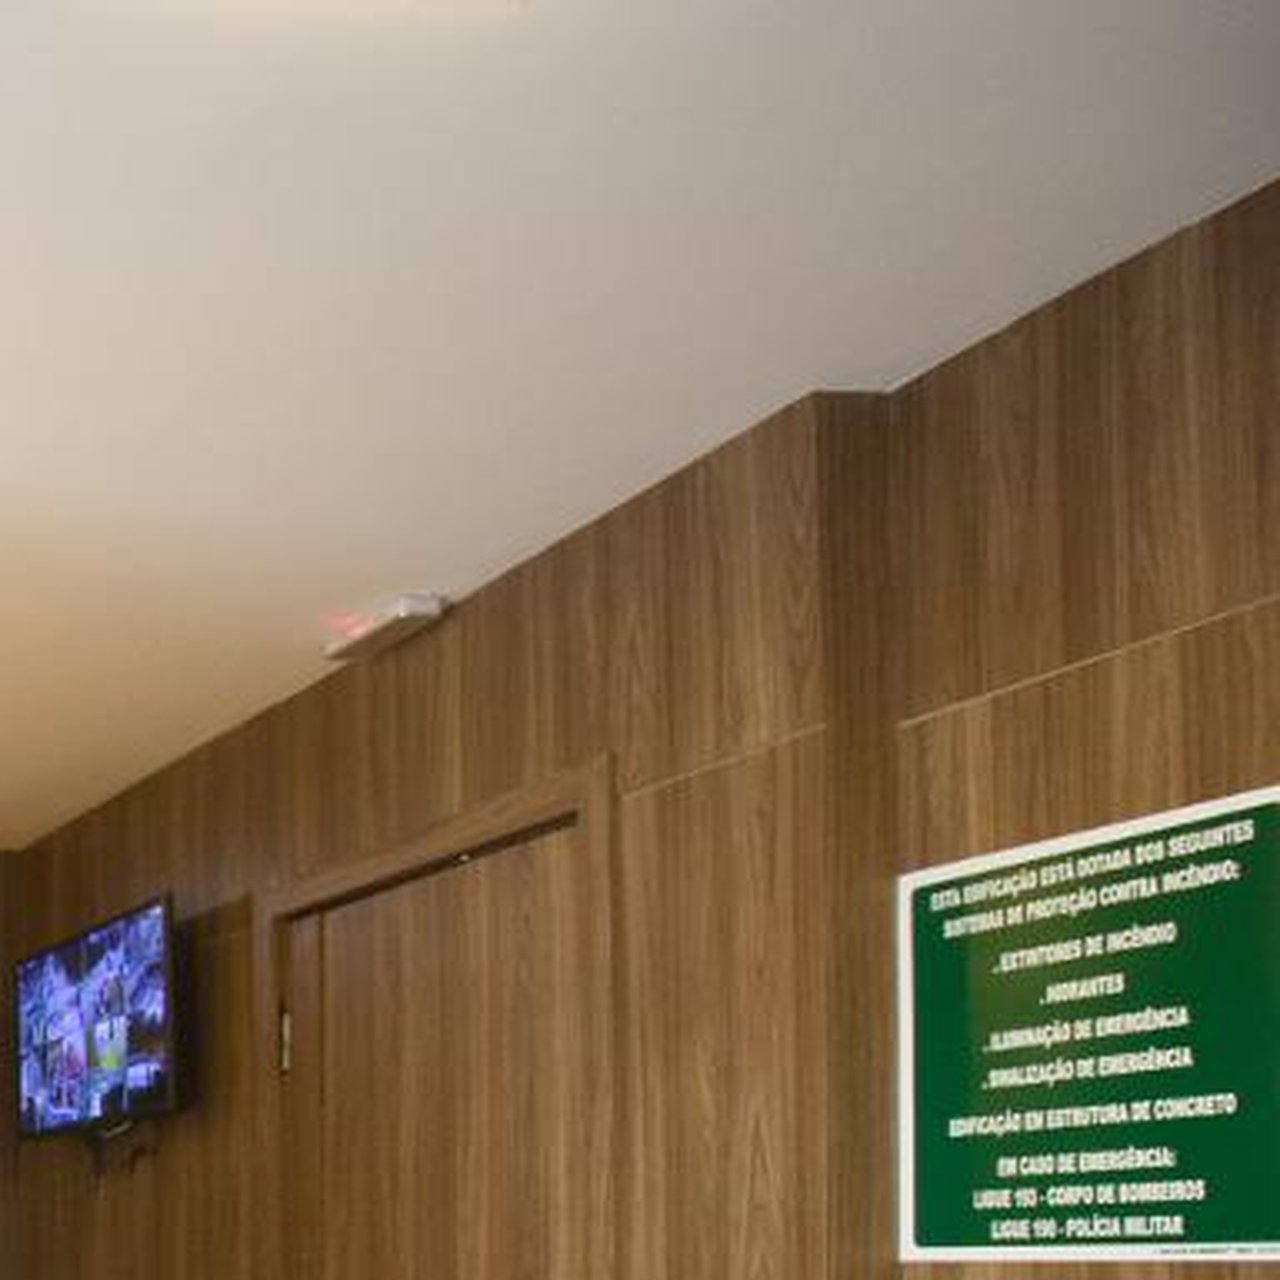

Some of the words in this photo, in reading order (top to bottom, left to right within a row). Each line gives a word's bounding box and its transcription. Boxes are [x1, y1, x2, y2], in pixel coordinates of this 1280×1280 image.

[930, 888, 961, 911] ESTA
[962, 868, 1037, 904] EDIFICAÇÃO
[1040, 857, 1074, 887] ESTÁ
[1076, 849, 1132, 878] DOTADA
[1135, 840, 1165, 865] DOS
[1168, 819, 1255, 857] SEGUINTES
[1006, 905, 1024, 926] DE
[1026, 886, 1097, 922] PROTEÇÃO
[1100, 877, 1160, 907] CONTRA
[1085, 934, 1104, 957] DE
[1106, 921, 1177, 951] INCÊNDIO
[1074, 1019, 1093, 1040] DE
[1095, 1006, 1190, 1037] EMERGÊNCIA
[1076, 1057, 1095, 1078] DE
[1097, 1046, 1193, 1077] EMERGÊNCIA
[949, 1107, 1020, 1138] EDIFICAÇÃO
[1024, 1109, 1043, 1131] EM
[1045, 1102, 1127, 1130] ESTRUTURA
[1130, 1100, 1150, 1121] DE
[1153, 1092, 1238, 1120] CONCRETO
[997, 1157, 1017, 1178] EM
[1020, 1154, 1054, 1175] CASO
[1057, 1152, 1077, 1174] DE
[973, 1188, 1012, 1209] LIGUE
[1046, 1184, 1094, 1207] CORPO
[1096, 1183, 1116, 1204] DE
[1118, 1179, 1205, 1204] BOMBEIROS
[991, 1218, 1030, 1240] LIGUE
[1066, 1212, 1121, 1238] POLÍCIA
[1123, 1215, 1183, 1237] MILITAR
